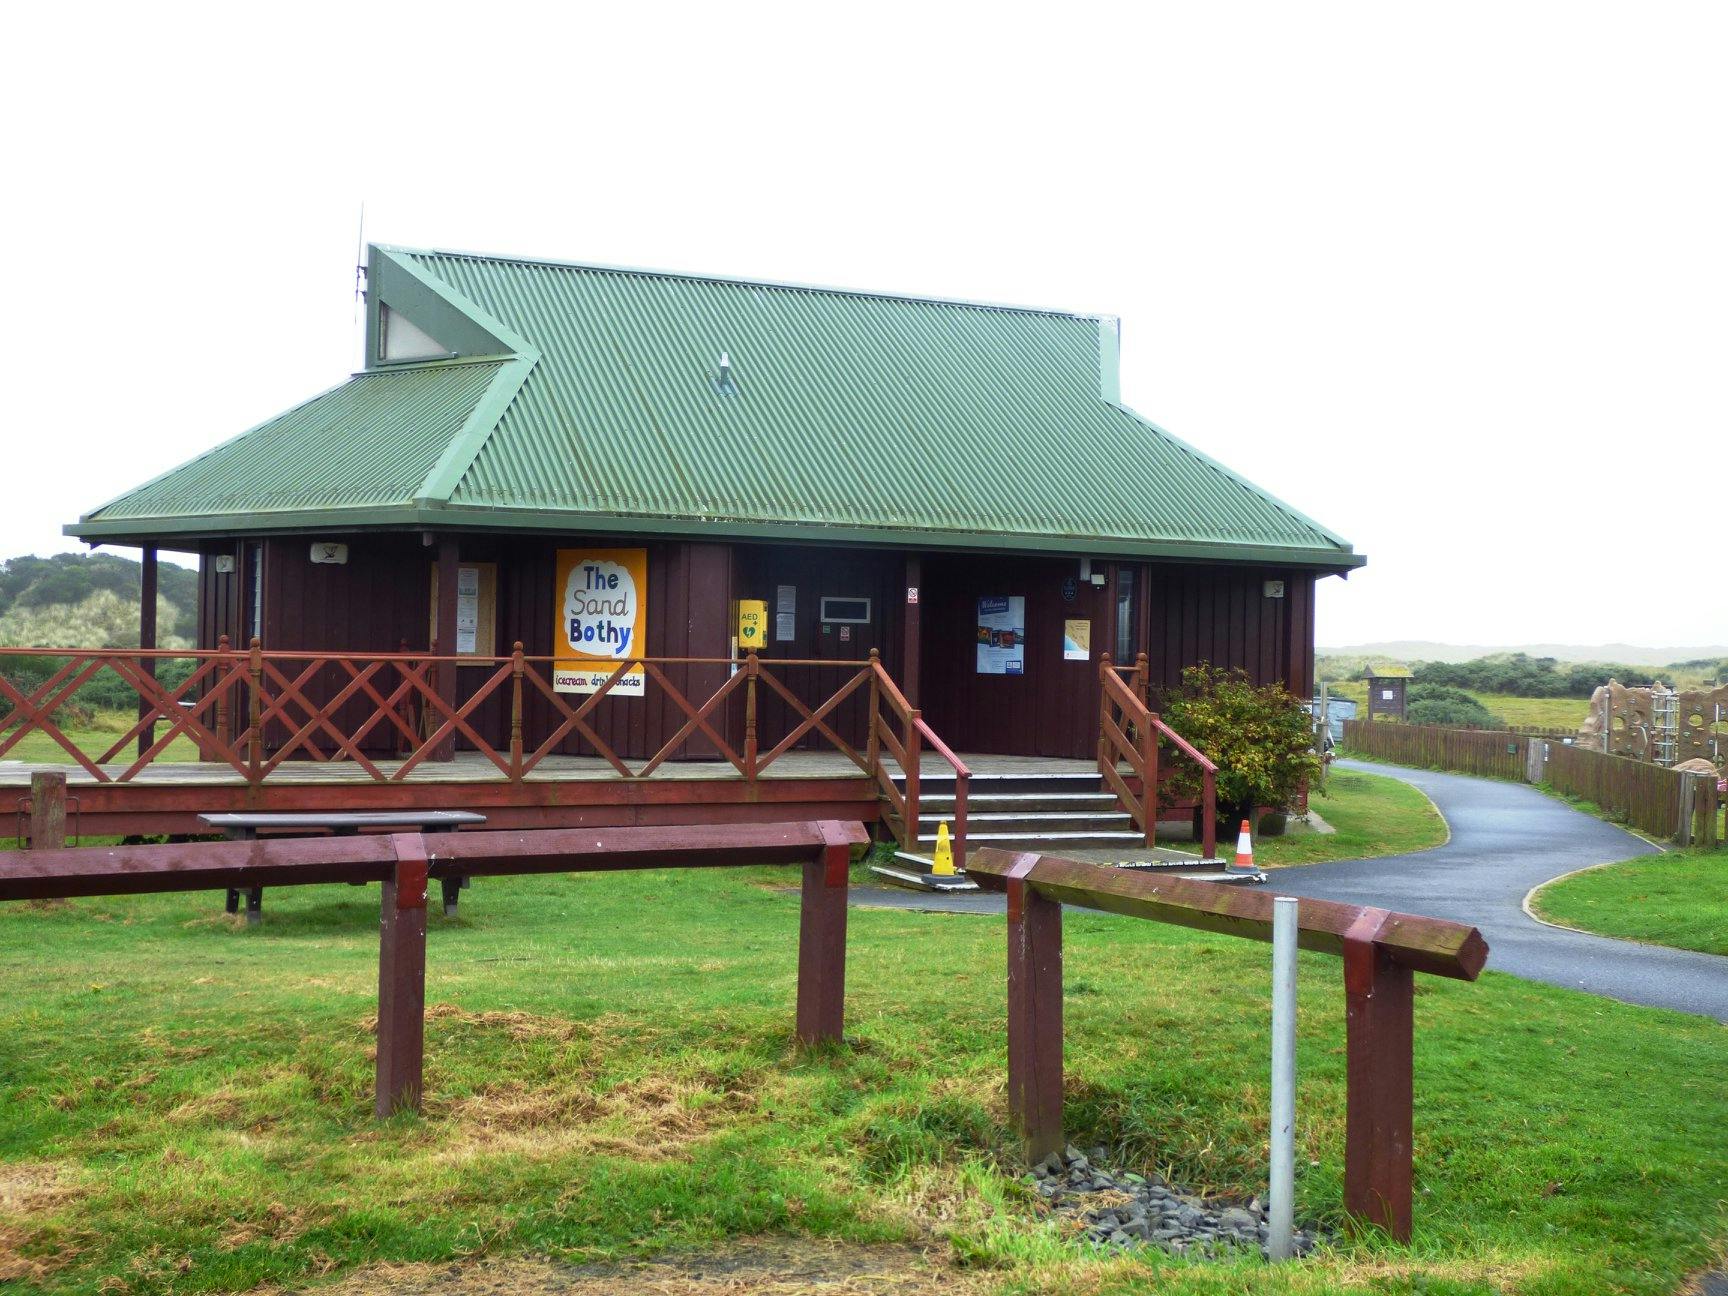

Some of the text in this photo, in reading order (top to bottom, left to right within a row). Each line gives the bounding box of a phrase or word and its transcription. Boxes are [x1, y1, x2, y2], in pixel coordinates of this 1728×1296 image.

[584, 566, 619, 590] The
[571, 590, 629, 616] Sand
[570, 618, 631, 655] Bothy
